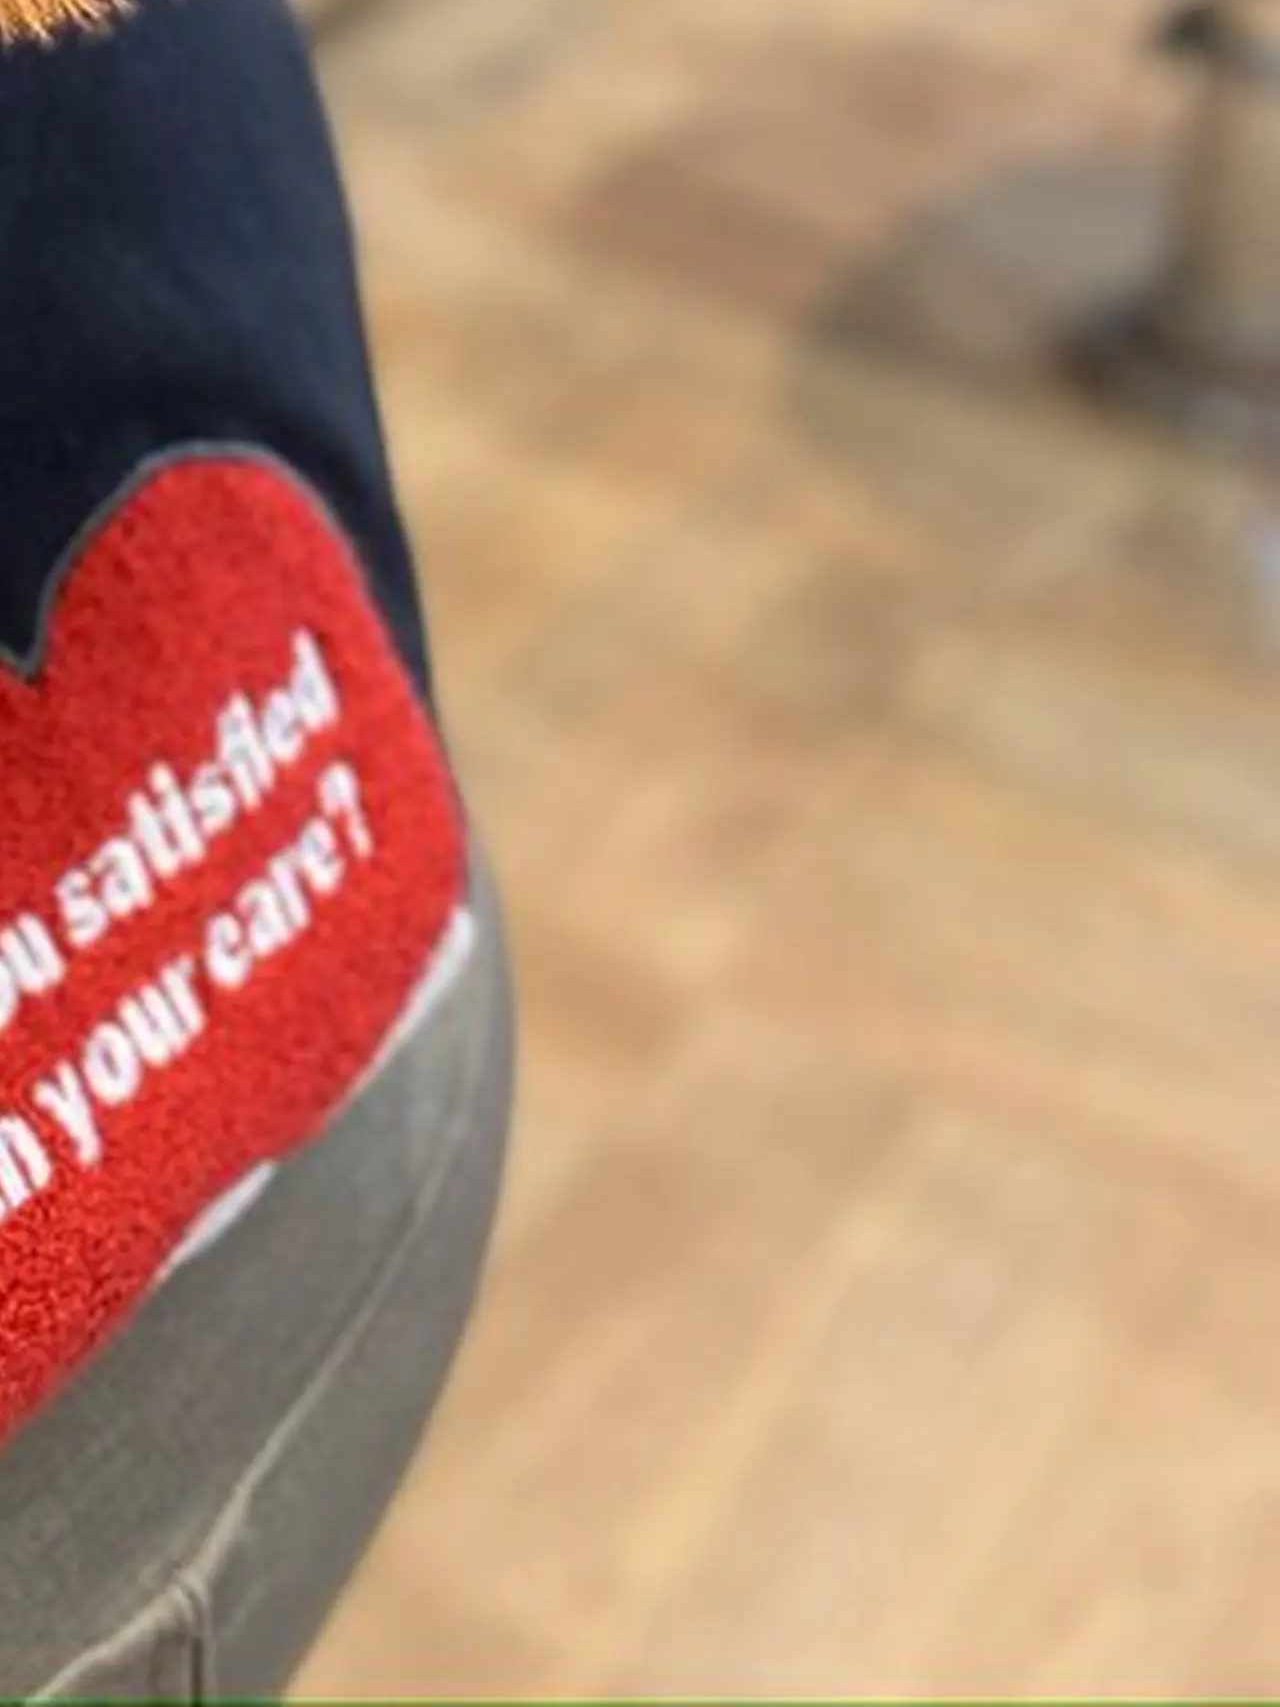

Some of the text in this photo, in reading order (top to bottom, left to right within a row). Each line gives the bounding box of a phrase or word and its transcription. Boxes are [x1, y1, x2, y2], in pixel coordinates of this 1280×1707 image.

[35, 955, 205, 1166] your
[203, 761, 373, 989] care?
[55, 627, 339, 948] satisfied
